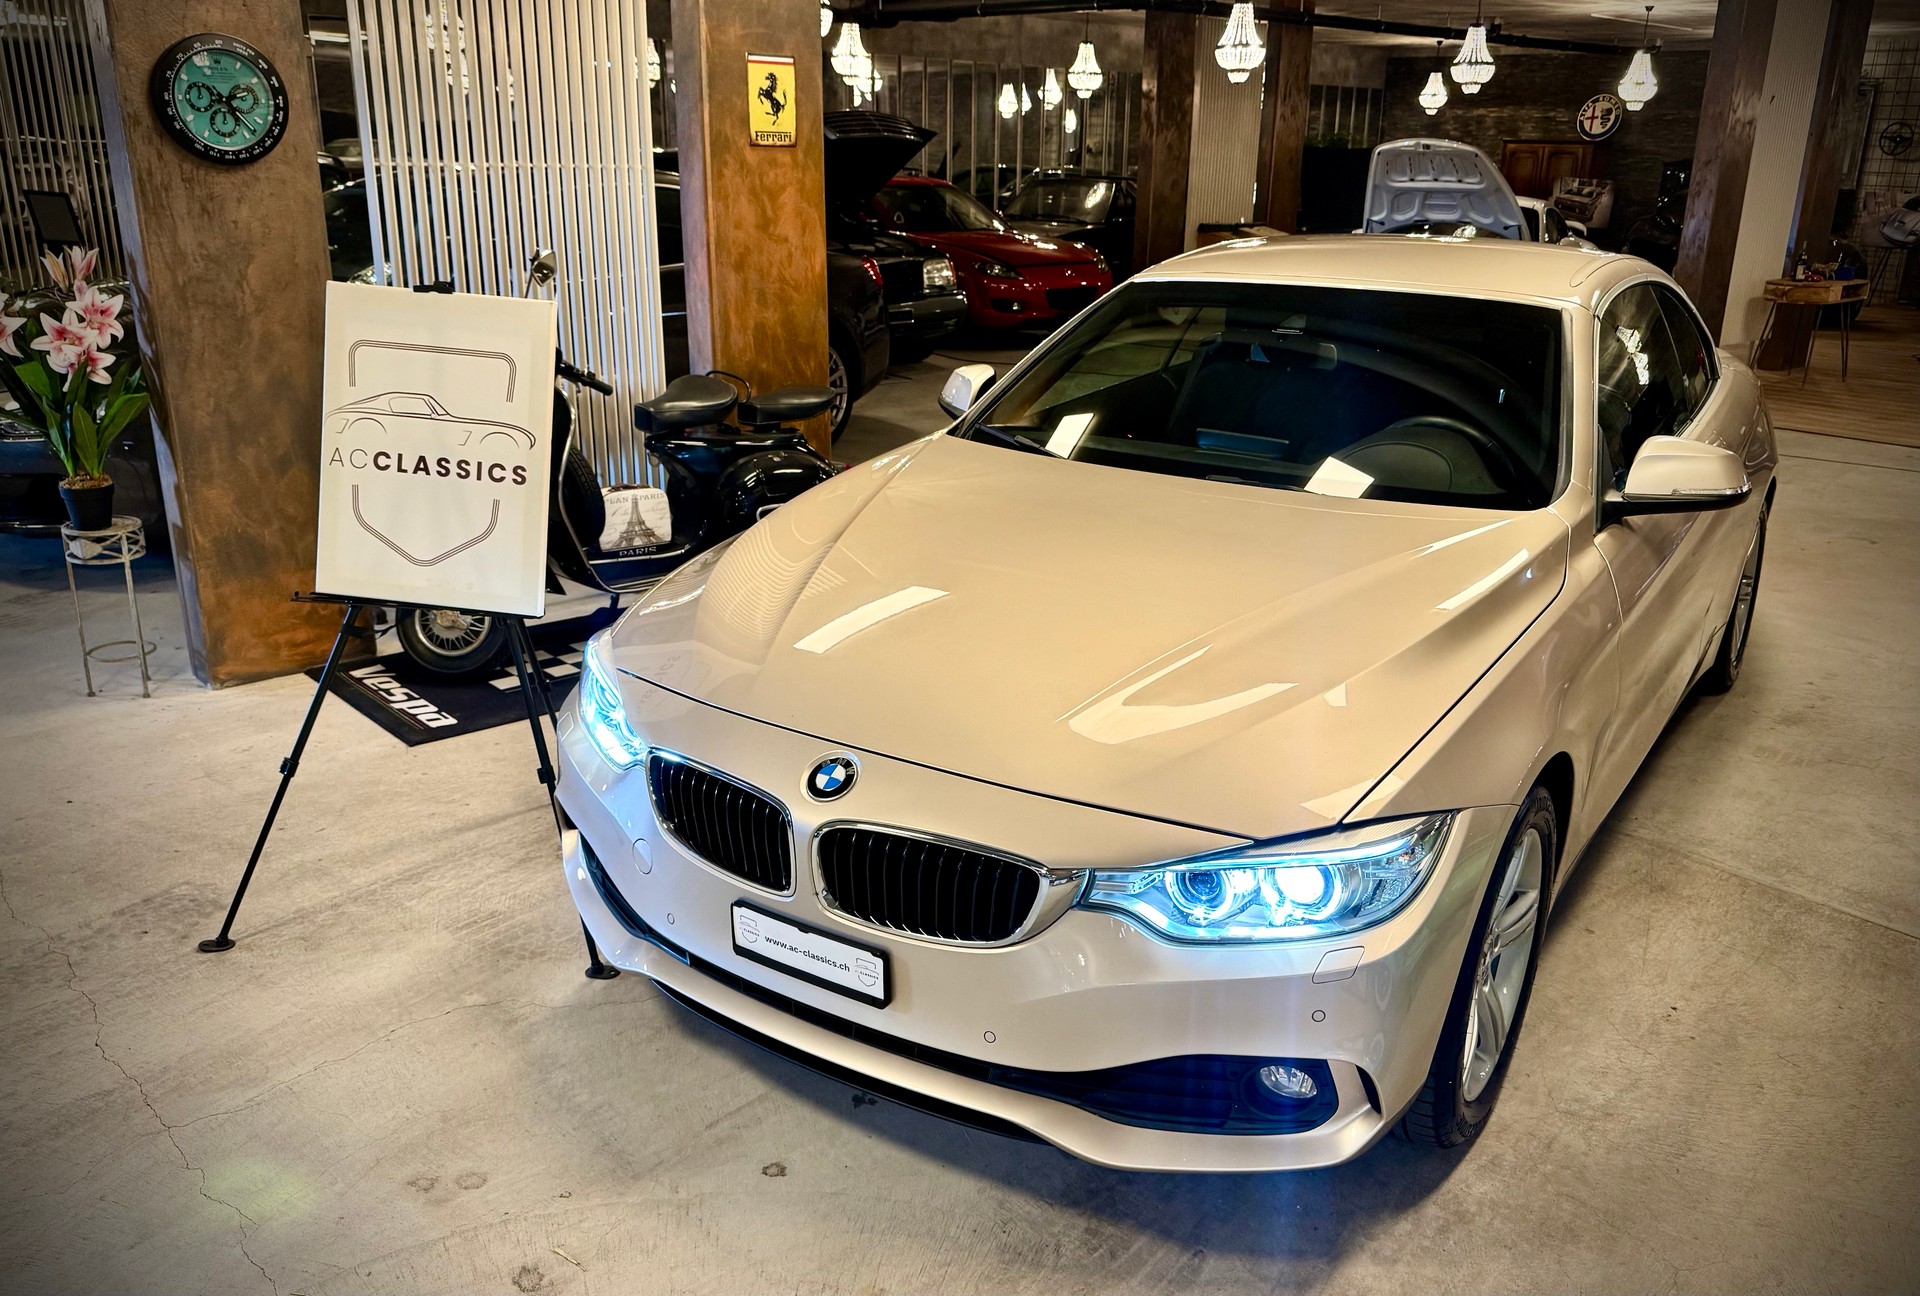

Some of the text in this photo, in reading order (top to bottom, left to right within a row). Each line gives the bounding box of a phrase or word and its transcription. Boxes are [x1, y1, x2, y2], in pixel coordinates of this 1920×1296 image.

[754, 130, 792, 143] Ferrari
[639, 493, 666, 502] PARIS
[619, 546, 657, 557] PARIS
[764, 934, 850, 973] www.ac-classics.ch
